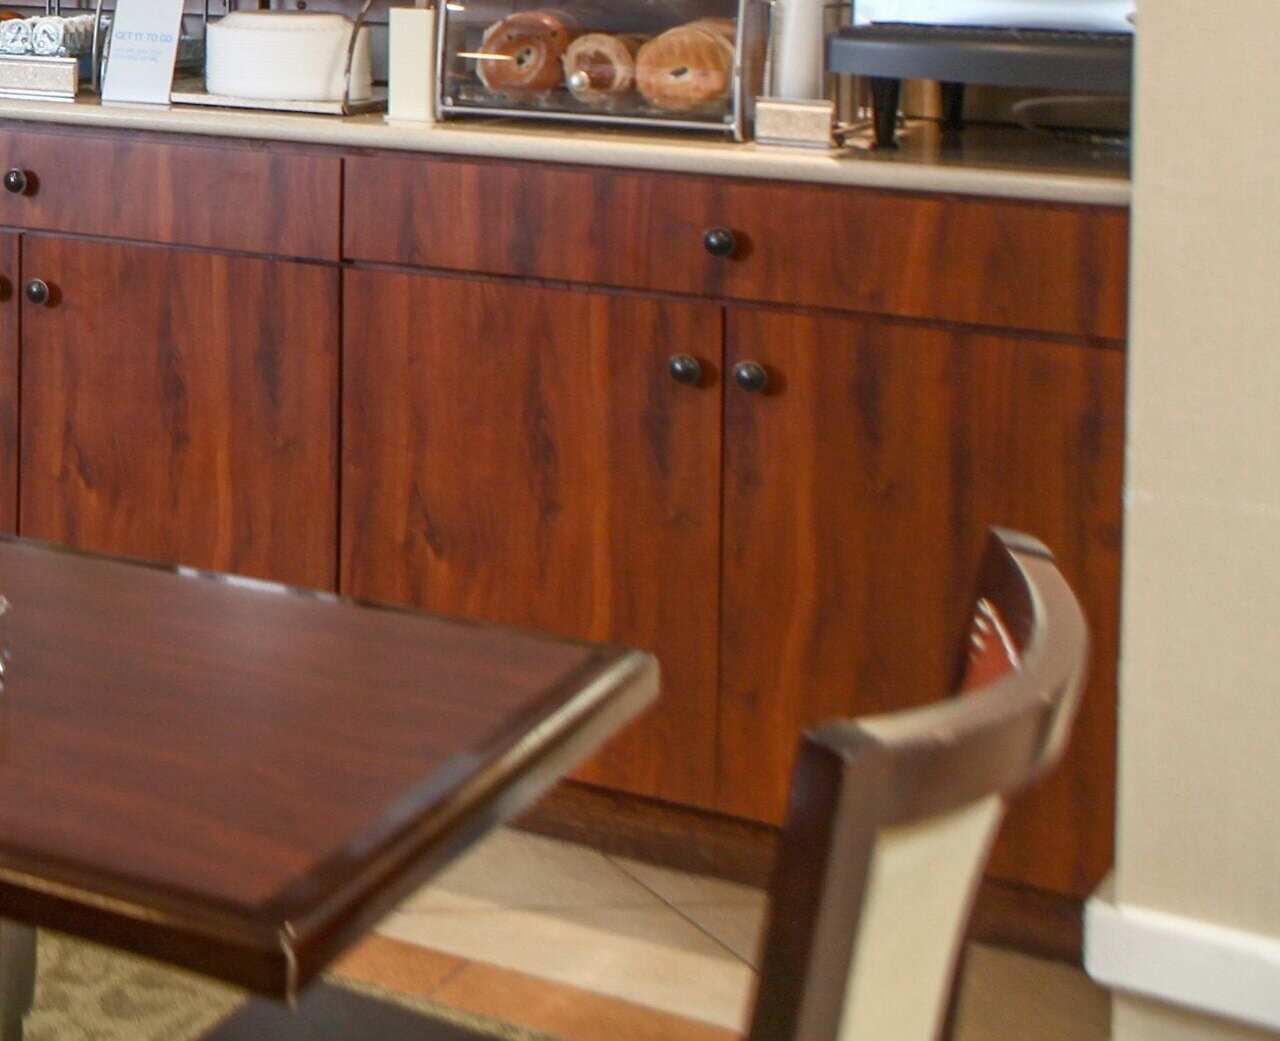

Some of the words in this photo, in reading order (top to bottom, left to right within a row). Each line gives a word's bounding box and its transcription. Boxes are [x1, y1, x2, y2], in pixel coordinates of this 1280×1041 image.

[115, 31, 132, 40] GET
[134, 32, 144, 41] IT
[146, 33, 158, 43] TO
